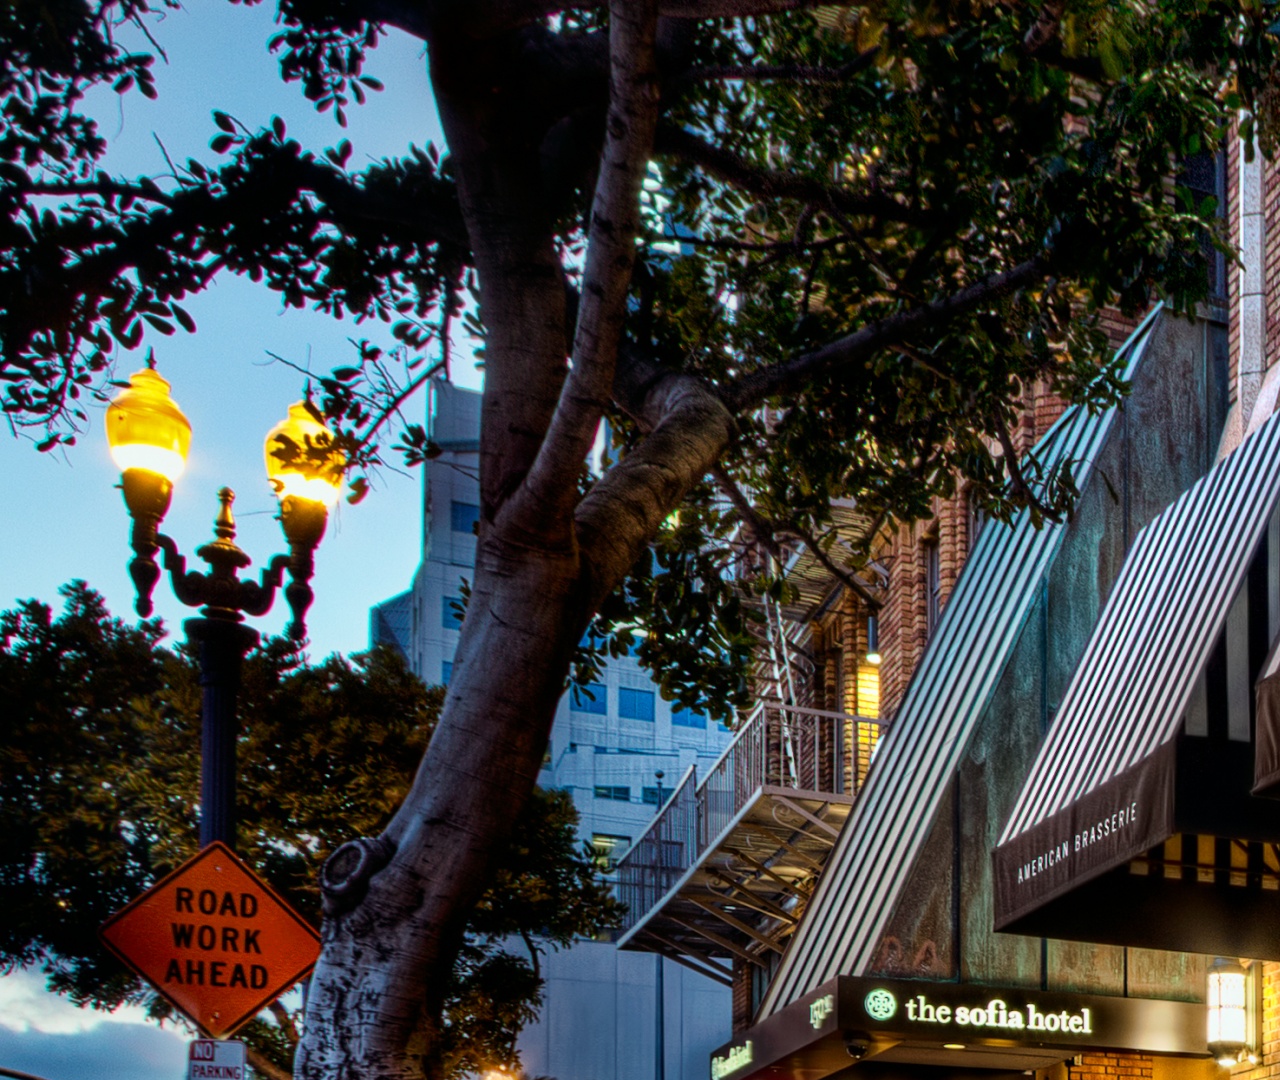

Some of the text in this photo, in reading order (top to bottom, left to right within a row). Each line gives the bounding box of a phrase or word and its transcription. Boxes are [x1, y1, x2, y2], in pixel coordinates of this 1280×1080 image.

[1018, 802, 1137, 884] AMERICAN BRASSERIE
[176, 887, 258, 918] ROAD
[171, 923, 262, 954] WORK
[165, 959, 268, 989] AHEAD
[905, 995, 1092, 1034] the sofia hotel
[194, 1042, 213, 1059] NO
[192, 1064, 241, 1080] PARKING
